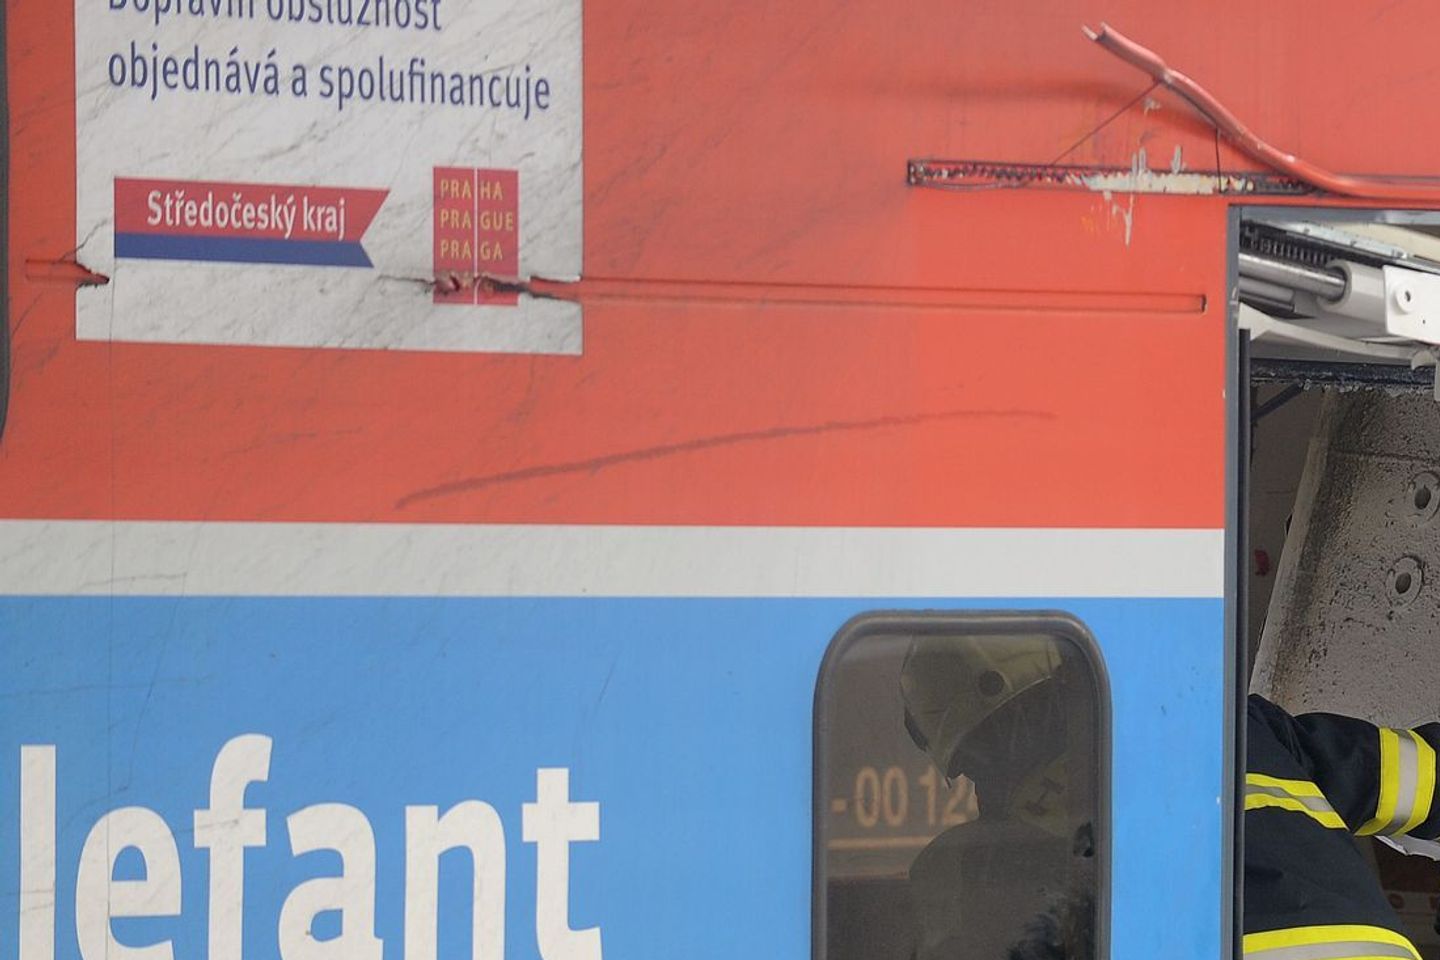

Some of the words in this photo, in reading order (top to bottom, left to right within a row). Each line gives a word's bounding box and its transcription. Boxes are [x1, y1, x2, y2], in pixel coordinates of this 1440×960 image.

[108, 40, 279, 101] objednává
[291, 63, 308, 97] a
[319, 55, 551, 120] spolufinancuje
[147, 190, 296, 240] Středočeský
[303, 196, 346, 242] kraj
